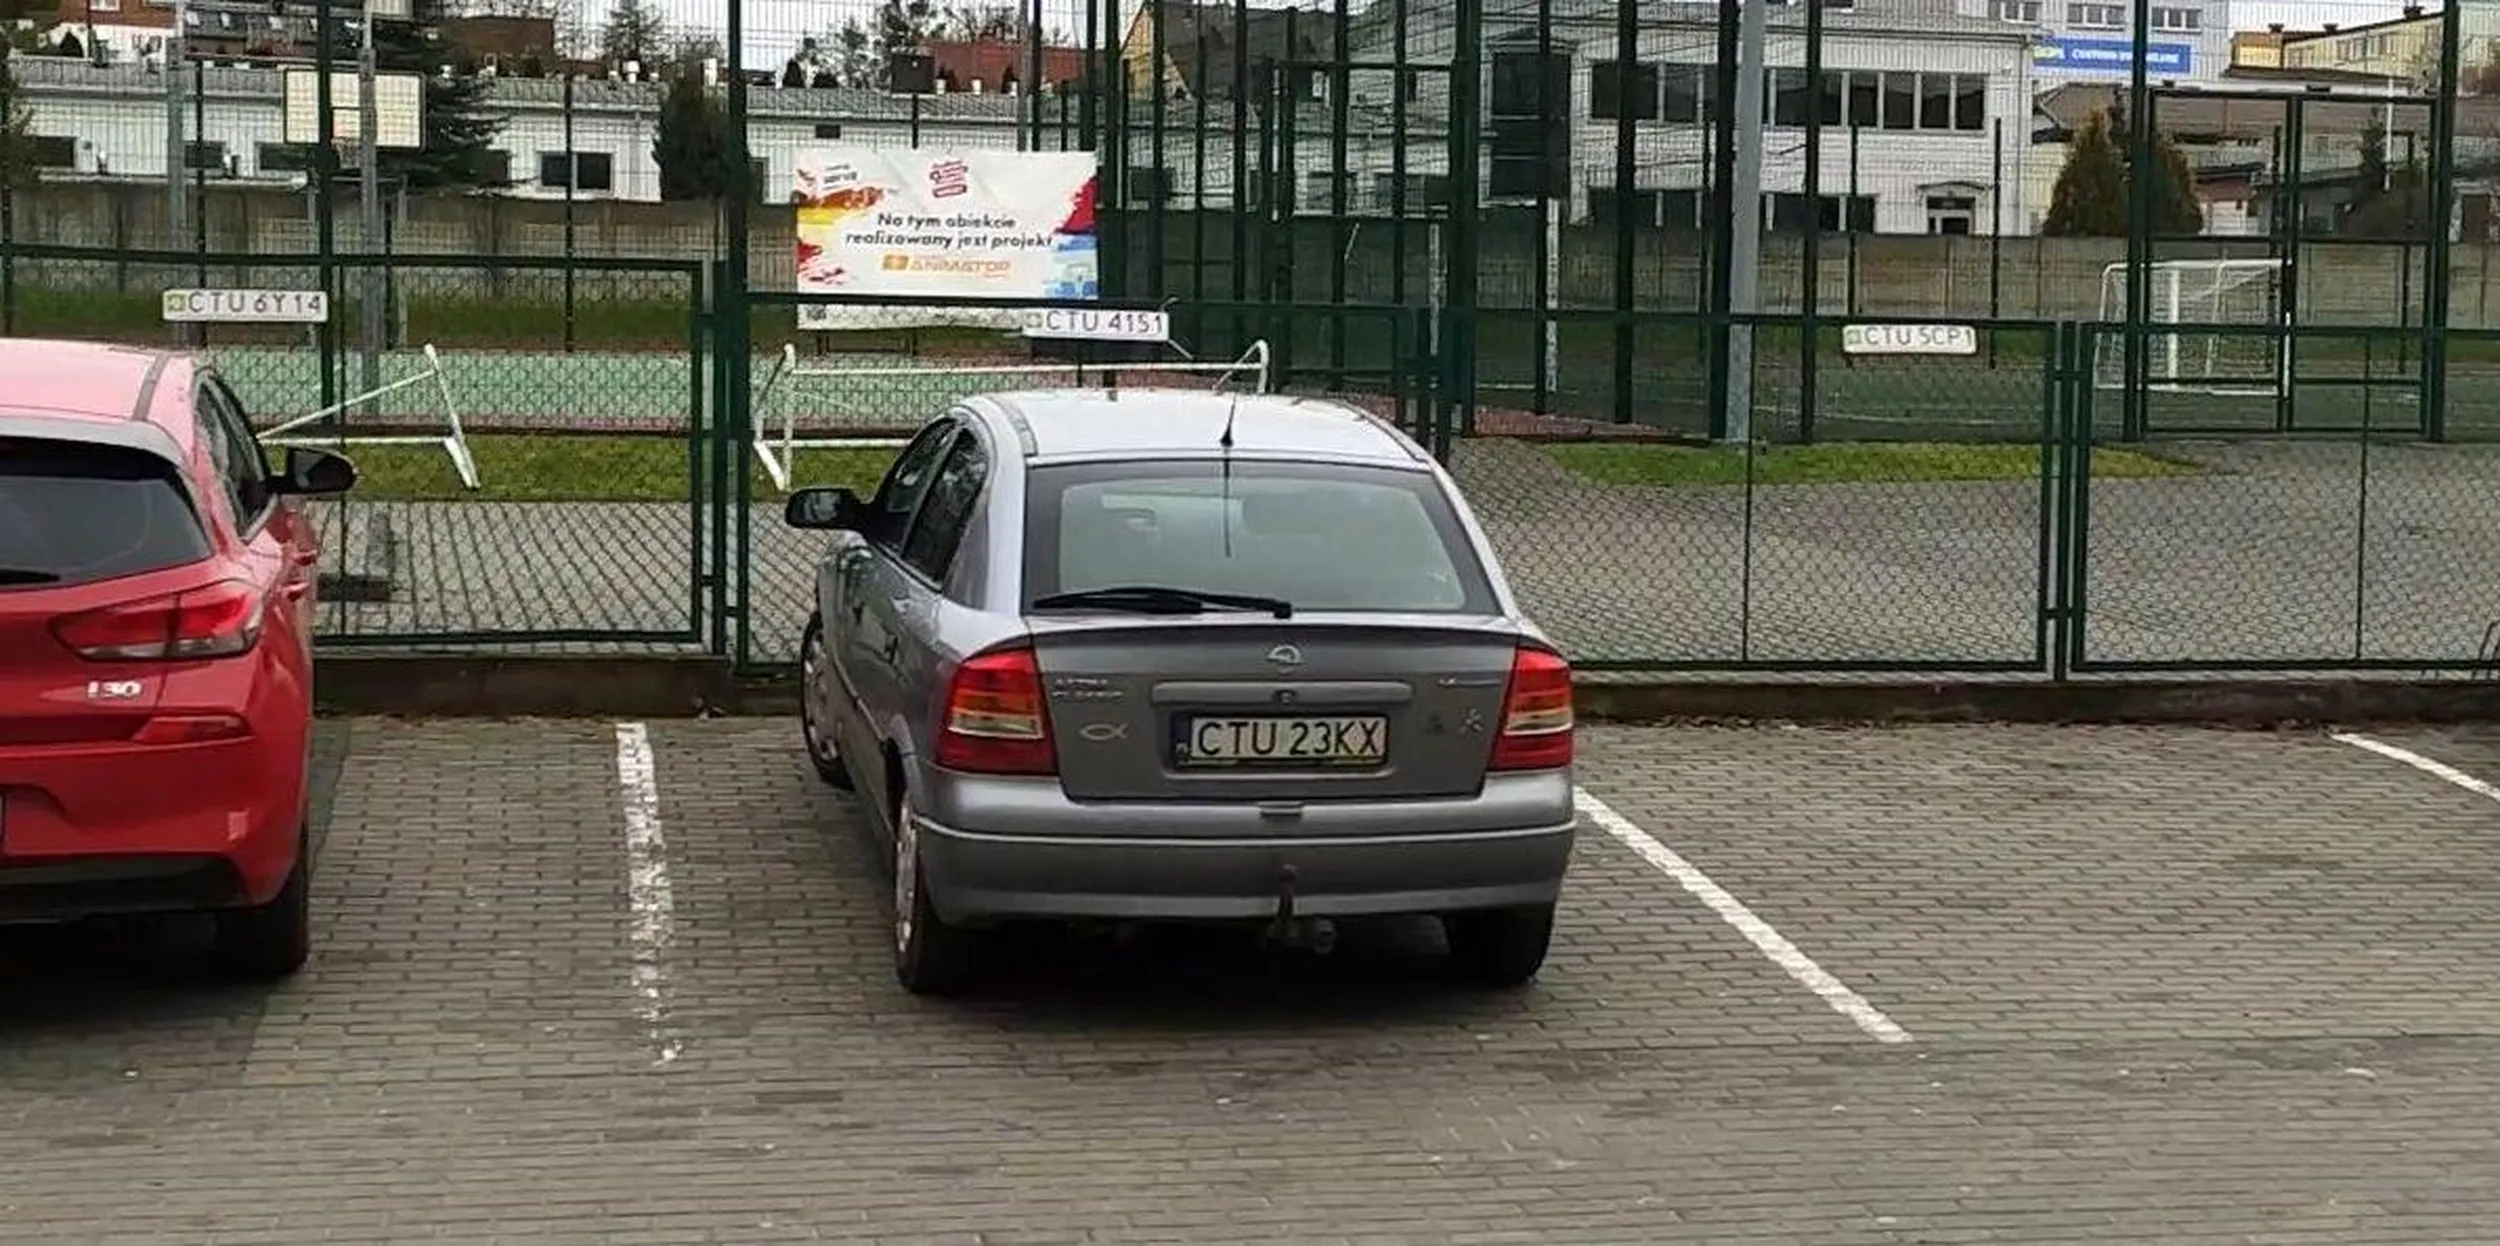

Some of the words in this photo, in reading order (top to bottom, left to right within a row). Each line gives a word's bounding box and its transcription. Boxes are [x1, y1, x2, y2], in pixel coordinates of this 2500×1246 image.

[877, 212, 903, 227] Na
[907, 214, 941, 231] tym
[945, 212, 1017, 228] obiekcie
[845, 230, 953, 249] realizowany
[957, 230, 988, 249] jest
[990, 231, 1053, 251] projekt
[188, 291, 246, 313] CTU
[253, 292, 322, 314] 6Y14
[1045, 309, 1099, 332] CTU
[1863, 326, 1912, 346] CTU
[1198, 721, 1278, 756] CTU
[1288, 720, 1381, 756] 23KX
